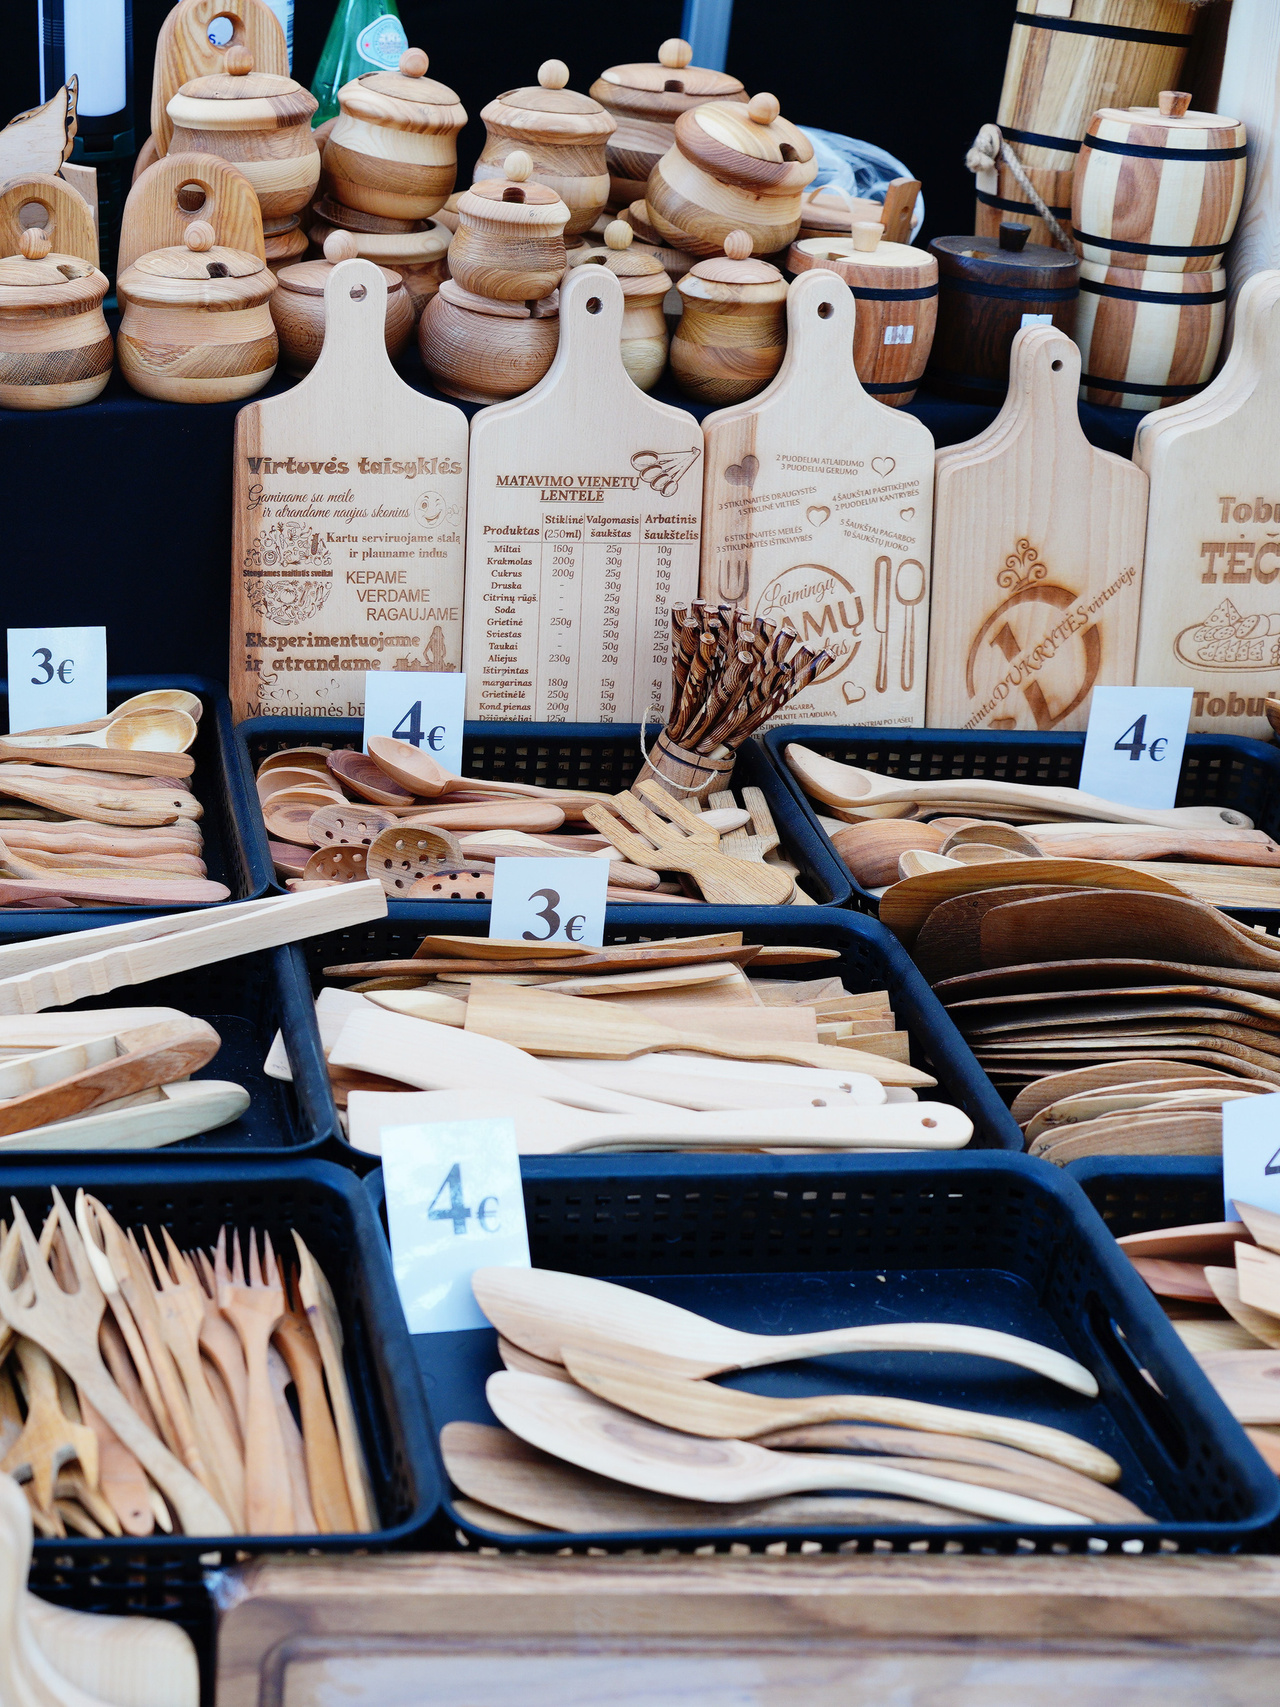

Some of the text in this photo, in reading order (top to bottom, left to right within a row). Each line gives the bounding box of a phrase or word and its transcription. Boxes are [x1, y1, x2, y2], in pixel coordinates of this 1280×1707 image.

[247, 457, 463, 479] Virtuvės taisyklės
[782, 454, 820, 464] PUODELIAI
[820, 457, 864, 468] ATLAIDUMO
[786, 464, 824, 473] PUODELIAI
[496, 475, 640, 490] MATAVIMO VIENETŲ
[246, 484, 355, 511] Gaminame su meile
[540, 488, 605, 501] LENTELĖ
[724, 493, 770, 510] STIKLINAITĖS
[772, 486, 817, 501] DRAUGYSTĖS
[837, 488, 871, 502] ŠAUKŠTAI
[872, 480, 920, 495] PASITIKĖJIMO
[743, 503, 775, 514] STIKLINĖ
[776, 499, 800, 510] VILTIES
[840, 497, 878, 510] PUODELIAI
[879, 489, 920, 503] KANTRYBĖS
[262, 504, 410, 524] ir atrandame naujus skonius
[545, 514, 697, 527] Stiklinė Valgomasis Arbatinis
[483, 525, 540, 536] Produktas
[544, 529, 699, 541] (250ml) šaukštas šaukštelis
[730, 528, 776, 542] STIKLINAITĖS
[778, 526, 802, 536] MEILĖS
[846, 518, 879, 534] ŠAUKŠTAI
[880, 529, 916, 544] PAGARBOS
[326, 531, 461, 545] Kartu serviruojame stalą
[722, 540, 768, 552] STIKLINAITĖS
[769, 534, 812, 546] IŠTIKIMYBĖS
[494, 545, 672, 556] Miltai 160g 25g 10g
[884, 540, 908, 552] JUOKO
[349, 548, 448, 561] ir plauname indus
[1200, 533, 1280, 584] TĖČ
[552, 557, 575, 567] 200g
[606, 558, 622, 567] 30g
[657, 558, 672, 568] 10g
[346, 571, 407, 584] KEPAME
[492, 570, 671, 580] Cukrus 200g 25g 10g
[491, 582, 670, 592] Druska 30g 10g
[357, 589, 431, 602] VERDAME
[482, 594, 515, 604] Citrinų
[604, 594, 620, 604] 25g
[655, 594, 666, 604] 8g
[762, 578, 836, 615] Laimingų
[366, 607, 459, 621] RAGAUJAME
[494, 606, 668, 616] Soda 28g 13g
[487, 618, 668, 628] Grietinė 250g 25g 10g
[773, 596, 865, 643] AMŲ
[245, 632, 420, 652] Eksperimentuojame
[486, 630, 669, 640] Sviestas 50g 25g
[489, 642, 668, 653] Taukai 50g 25g
[960, 566, 1136, 730] minta DUKRYTĖS virtuvėje
[31, 647, 76, 685] 3€
[245, 655, 382, 672] ir atrandame
[488, 654, 667, 665] Aliejus 230g 20g 10g
[482, 678, 662, 689] margarinas 180g 15g 4g
[482, 690, 662, 701] Grietinėlė 250g 15g 5g
[348, 702, 365, 717] bū
[546, 703, 569, 712] 200g
[600, 703, 616, 713] 30g
[1192, 691, 1276, 717] Tobu
[546, 714, 566, 722] 125g
[391, 700, 446, 751] 4€
[1114, 714, 1168, 762] 4€
[521, 888, 587, 942] 3€
[428, 1162, 502, 1235] 4€
